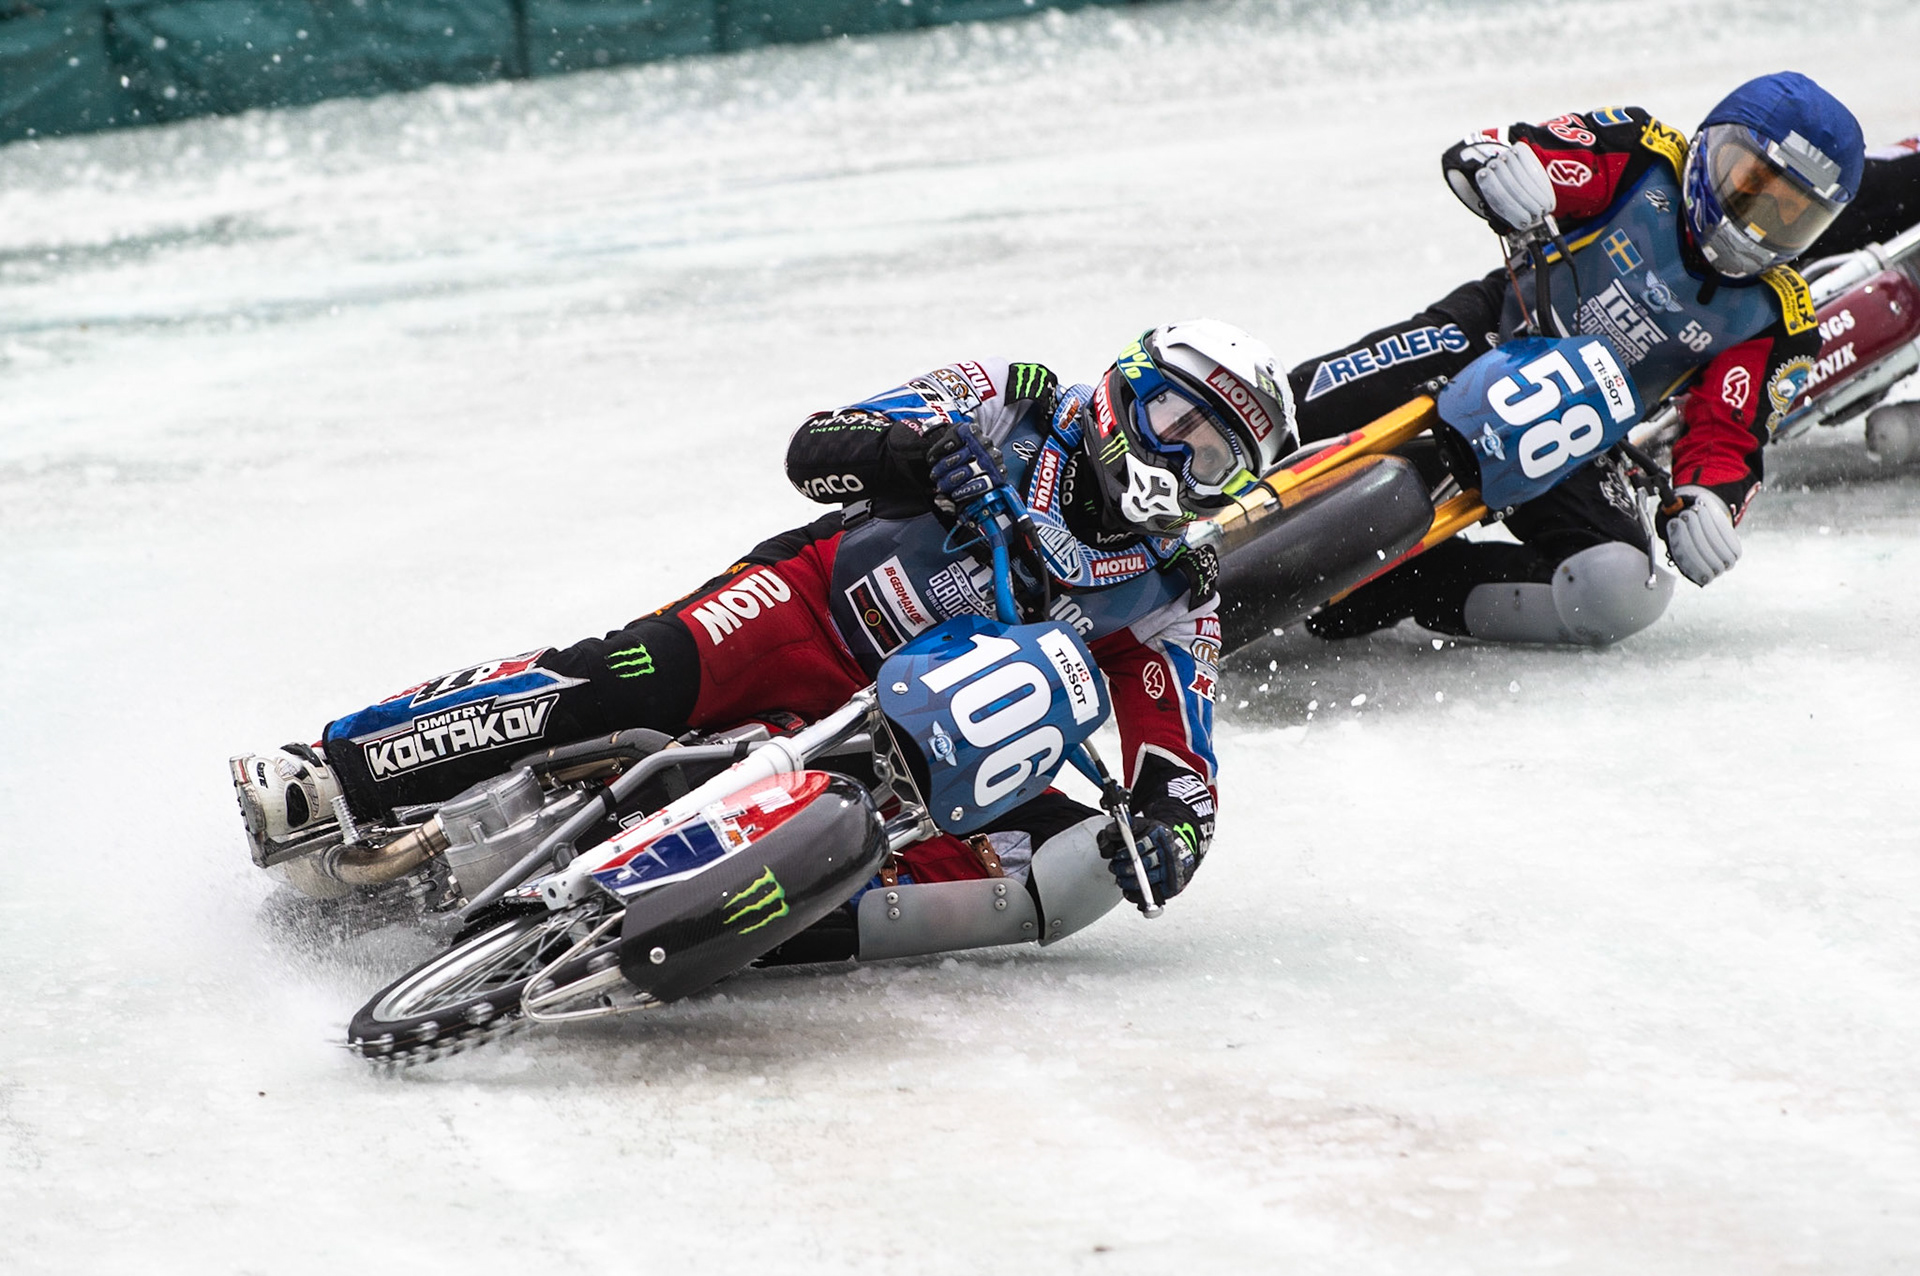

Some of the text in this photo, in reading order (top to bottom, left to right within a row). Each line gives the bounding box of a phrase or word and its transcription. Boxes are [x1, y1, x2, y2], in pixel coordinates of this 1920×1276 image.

[1589, 299, 1642, 358] SPEEDWAY
[1594, 282, 1663, 355] ICE
[1678, 320, 1713, 352] 58
[1328, 324, 1470, 386] REJLERS
[809, 423, 884, 435] ENERGY DRINK
[1210, 371, 1272, 440] MOTUL
[1487, 350, 1604, 480] 58
[1033, 450, 1060, 511] MOTUL
[883, 564, 897, 578] JB
[888, 575, 917, 615] GERMAN
[948, 564, 995, 621] SPEEDW
[1094, 556, 1145, 578] MOTUL
[691, 568, 792, 646] MOTU
[924, 588, 942, 611] WORLD
[1050, 595, 1094, 637] 106
[1054, 647, 1088, 706] TISSOT
[371, 699, 549, 777] KOLTAKOV
[416, 703, 489, 733] DMITRY
[919, 633, 1065, 808] 106
[935, 736, 949, 754] FIM
